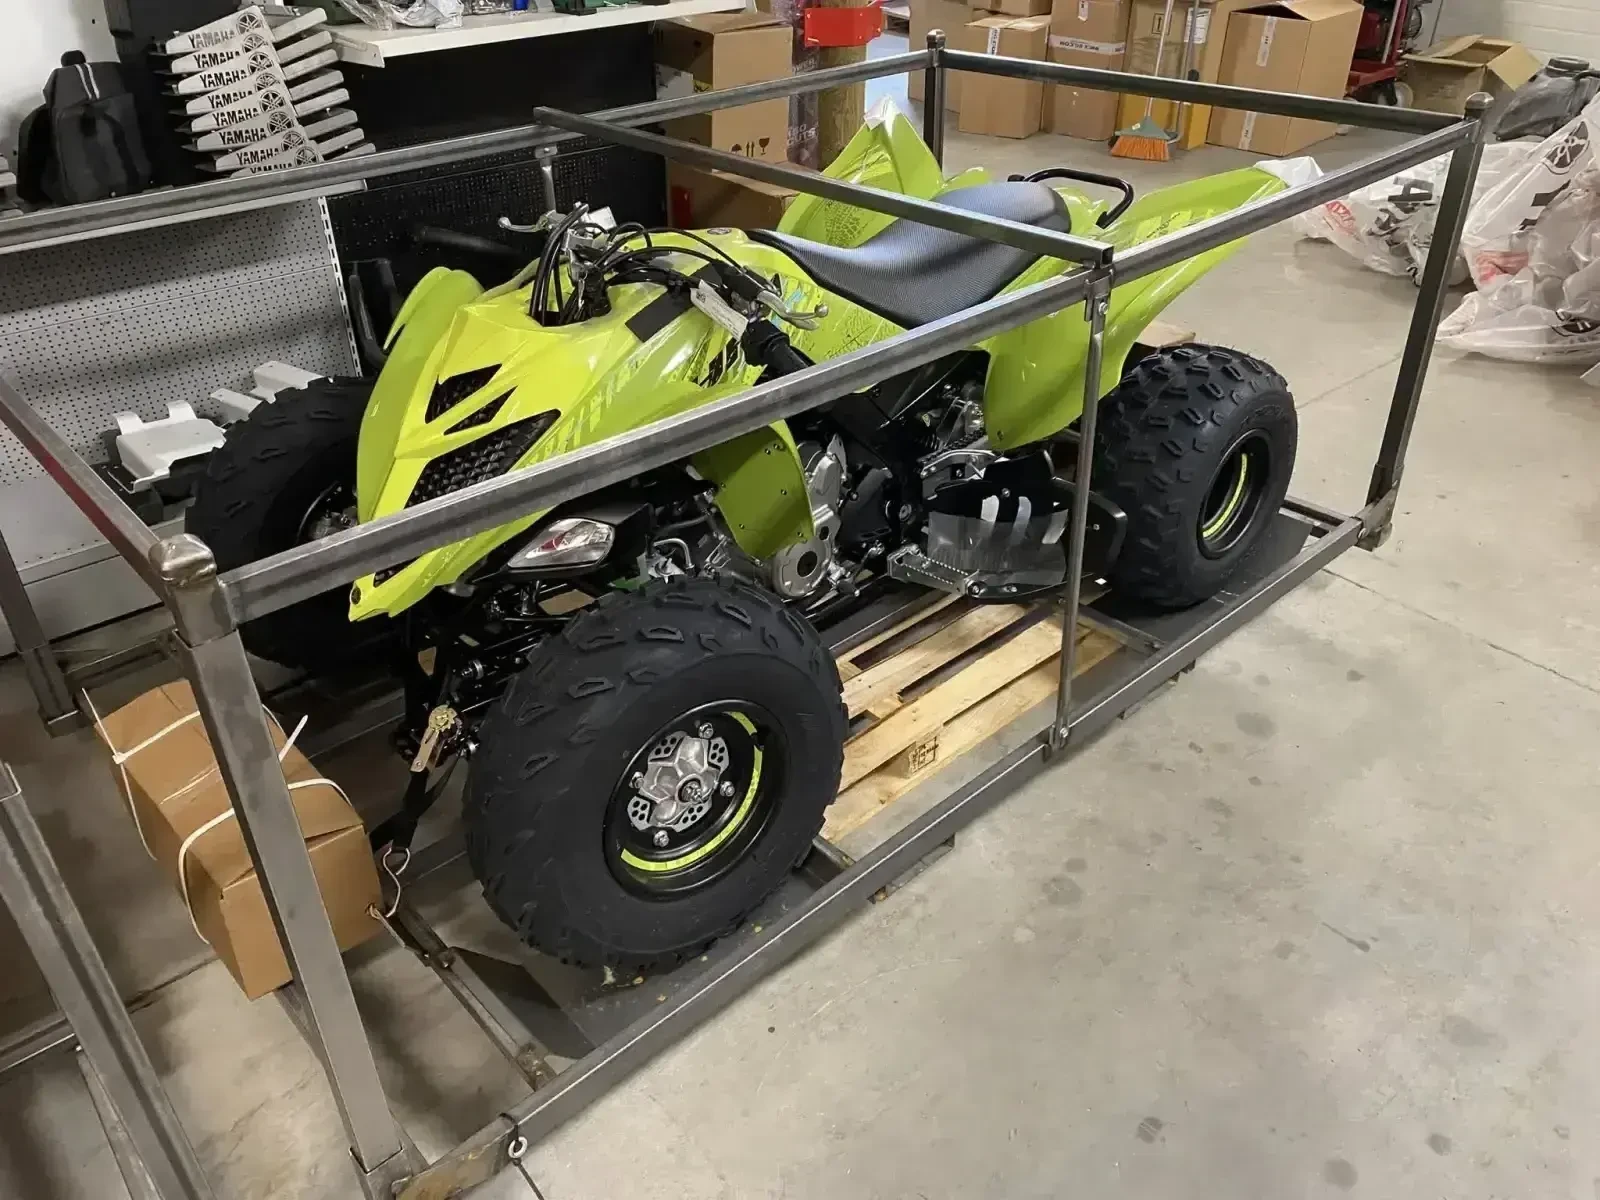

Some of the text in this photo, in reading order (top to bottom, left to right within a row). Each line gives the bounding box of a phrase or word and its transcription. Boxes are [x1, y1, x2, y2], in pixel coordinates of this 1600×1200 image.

[188, 30, 235, 48] YAMAHA
[200, 70, 247, 88] YAMAHA
[213, 108, 259, 126] YAMAHA
[219, 128, 267, 145] YAMAHA
[236, 148, 279, 165] YAMAHA
